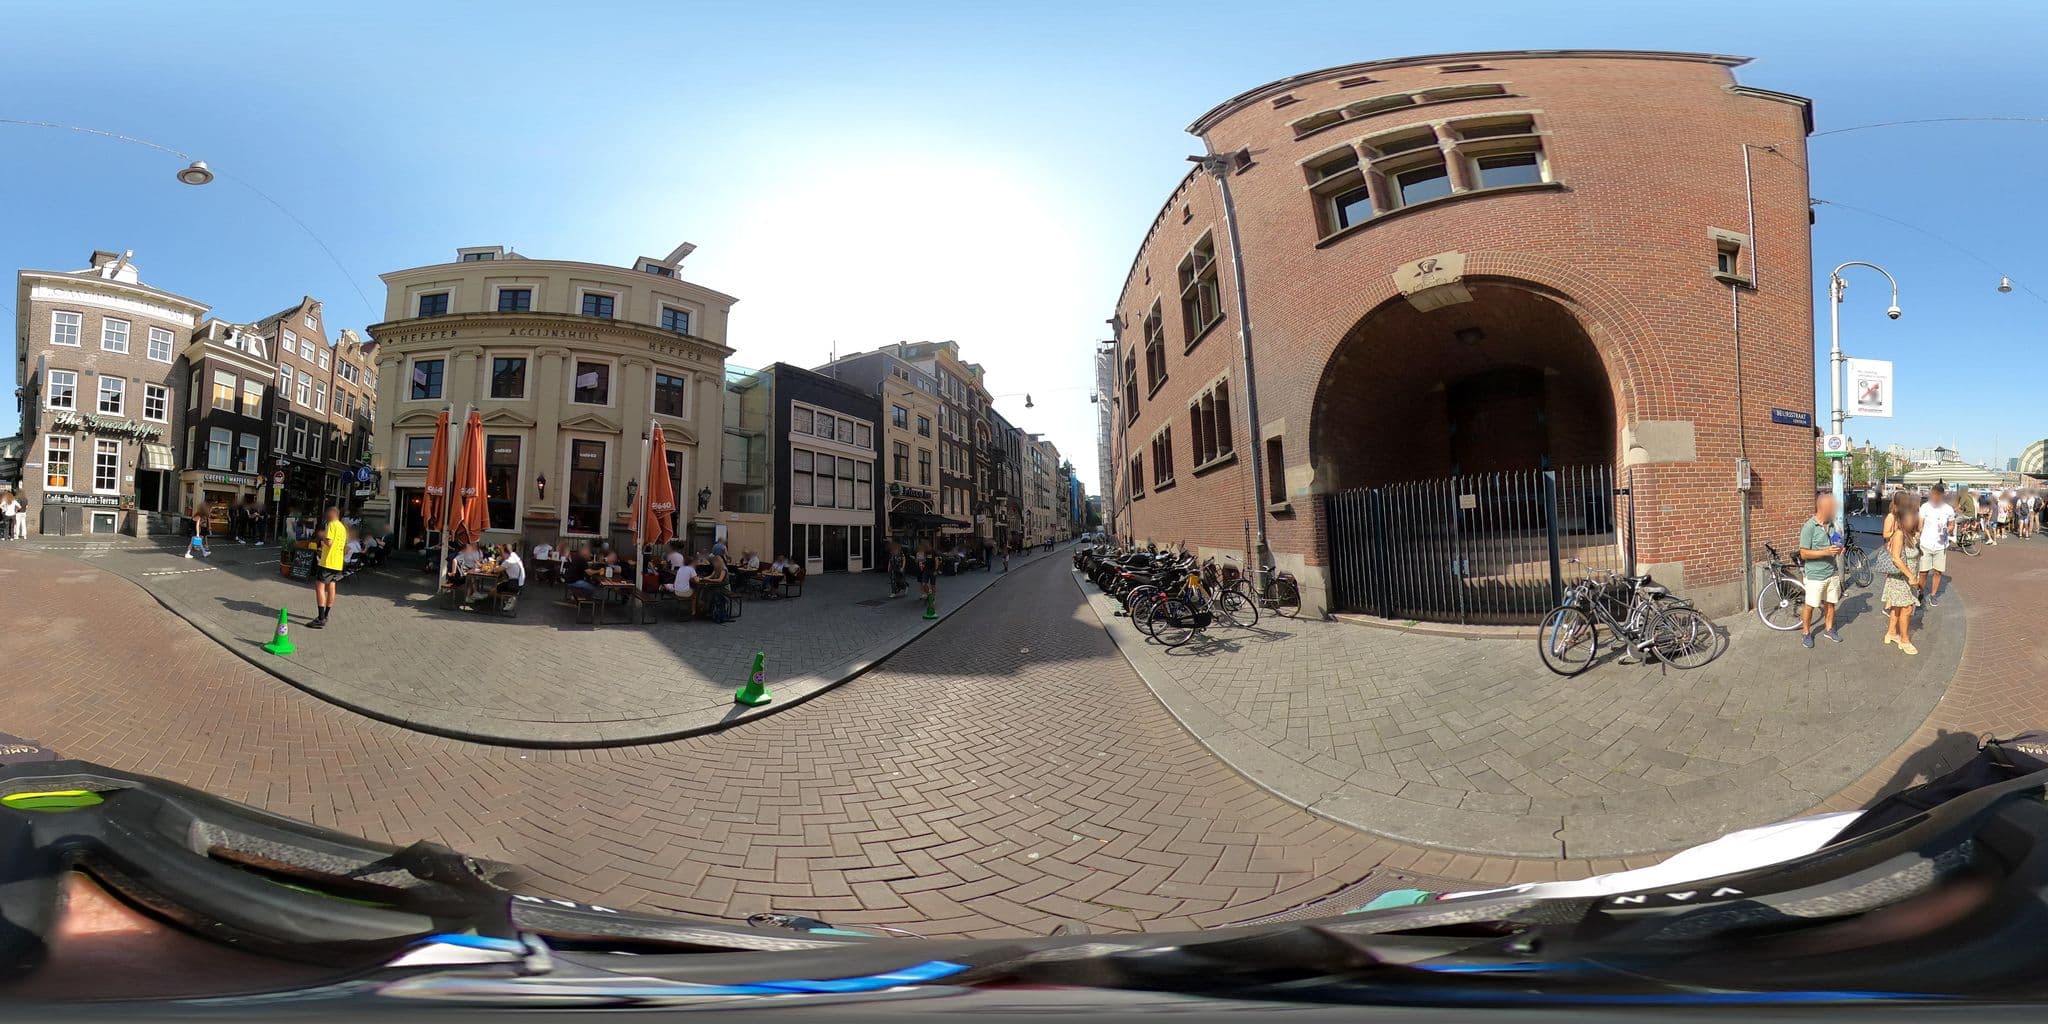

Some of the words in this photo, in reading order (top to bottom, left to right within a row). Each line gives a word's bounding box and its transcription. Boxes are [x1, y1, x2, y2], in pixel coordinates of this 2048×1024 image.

[400, 330, 457, 343] HEFFER
[509, 328, 599, 340] ACCIJNSHUIS
[54, 410, 82, 427] The
[89, 413, 164, 438] Grasshopper
